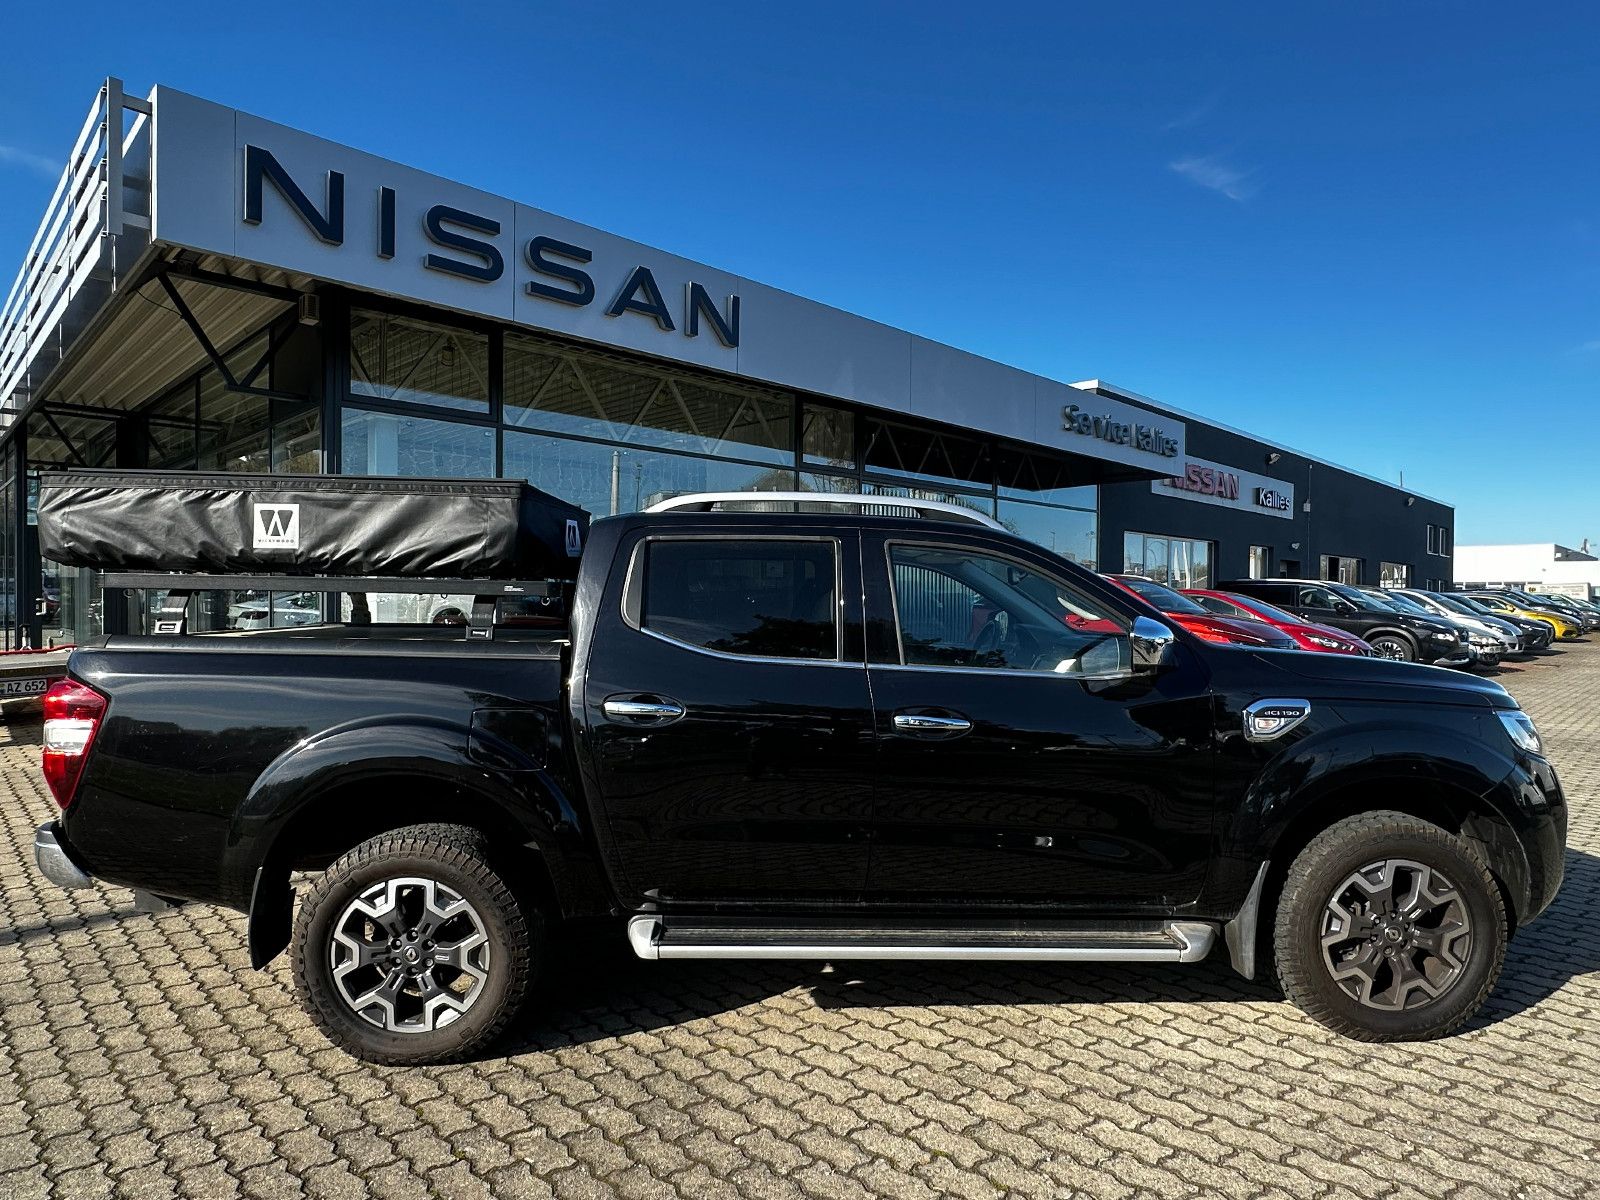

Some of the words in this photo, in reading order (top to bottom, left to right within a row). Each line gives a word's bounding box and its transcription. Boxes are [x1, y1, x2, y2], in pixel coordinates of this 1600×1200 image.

[243, 143, 740, 348] NISSAN
[1062, 404, 1130, 444] Service
[1130, 423, 1179, 457] Kallies
[1258, 487, 1291, 511] Kallies
[7, 682, 21, 693] AZ
[25, 680, 46, 692] 652
